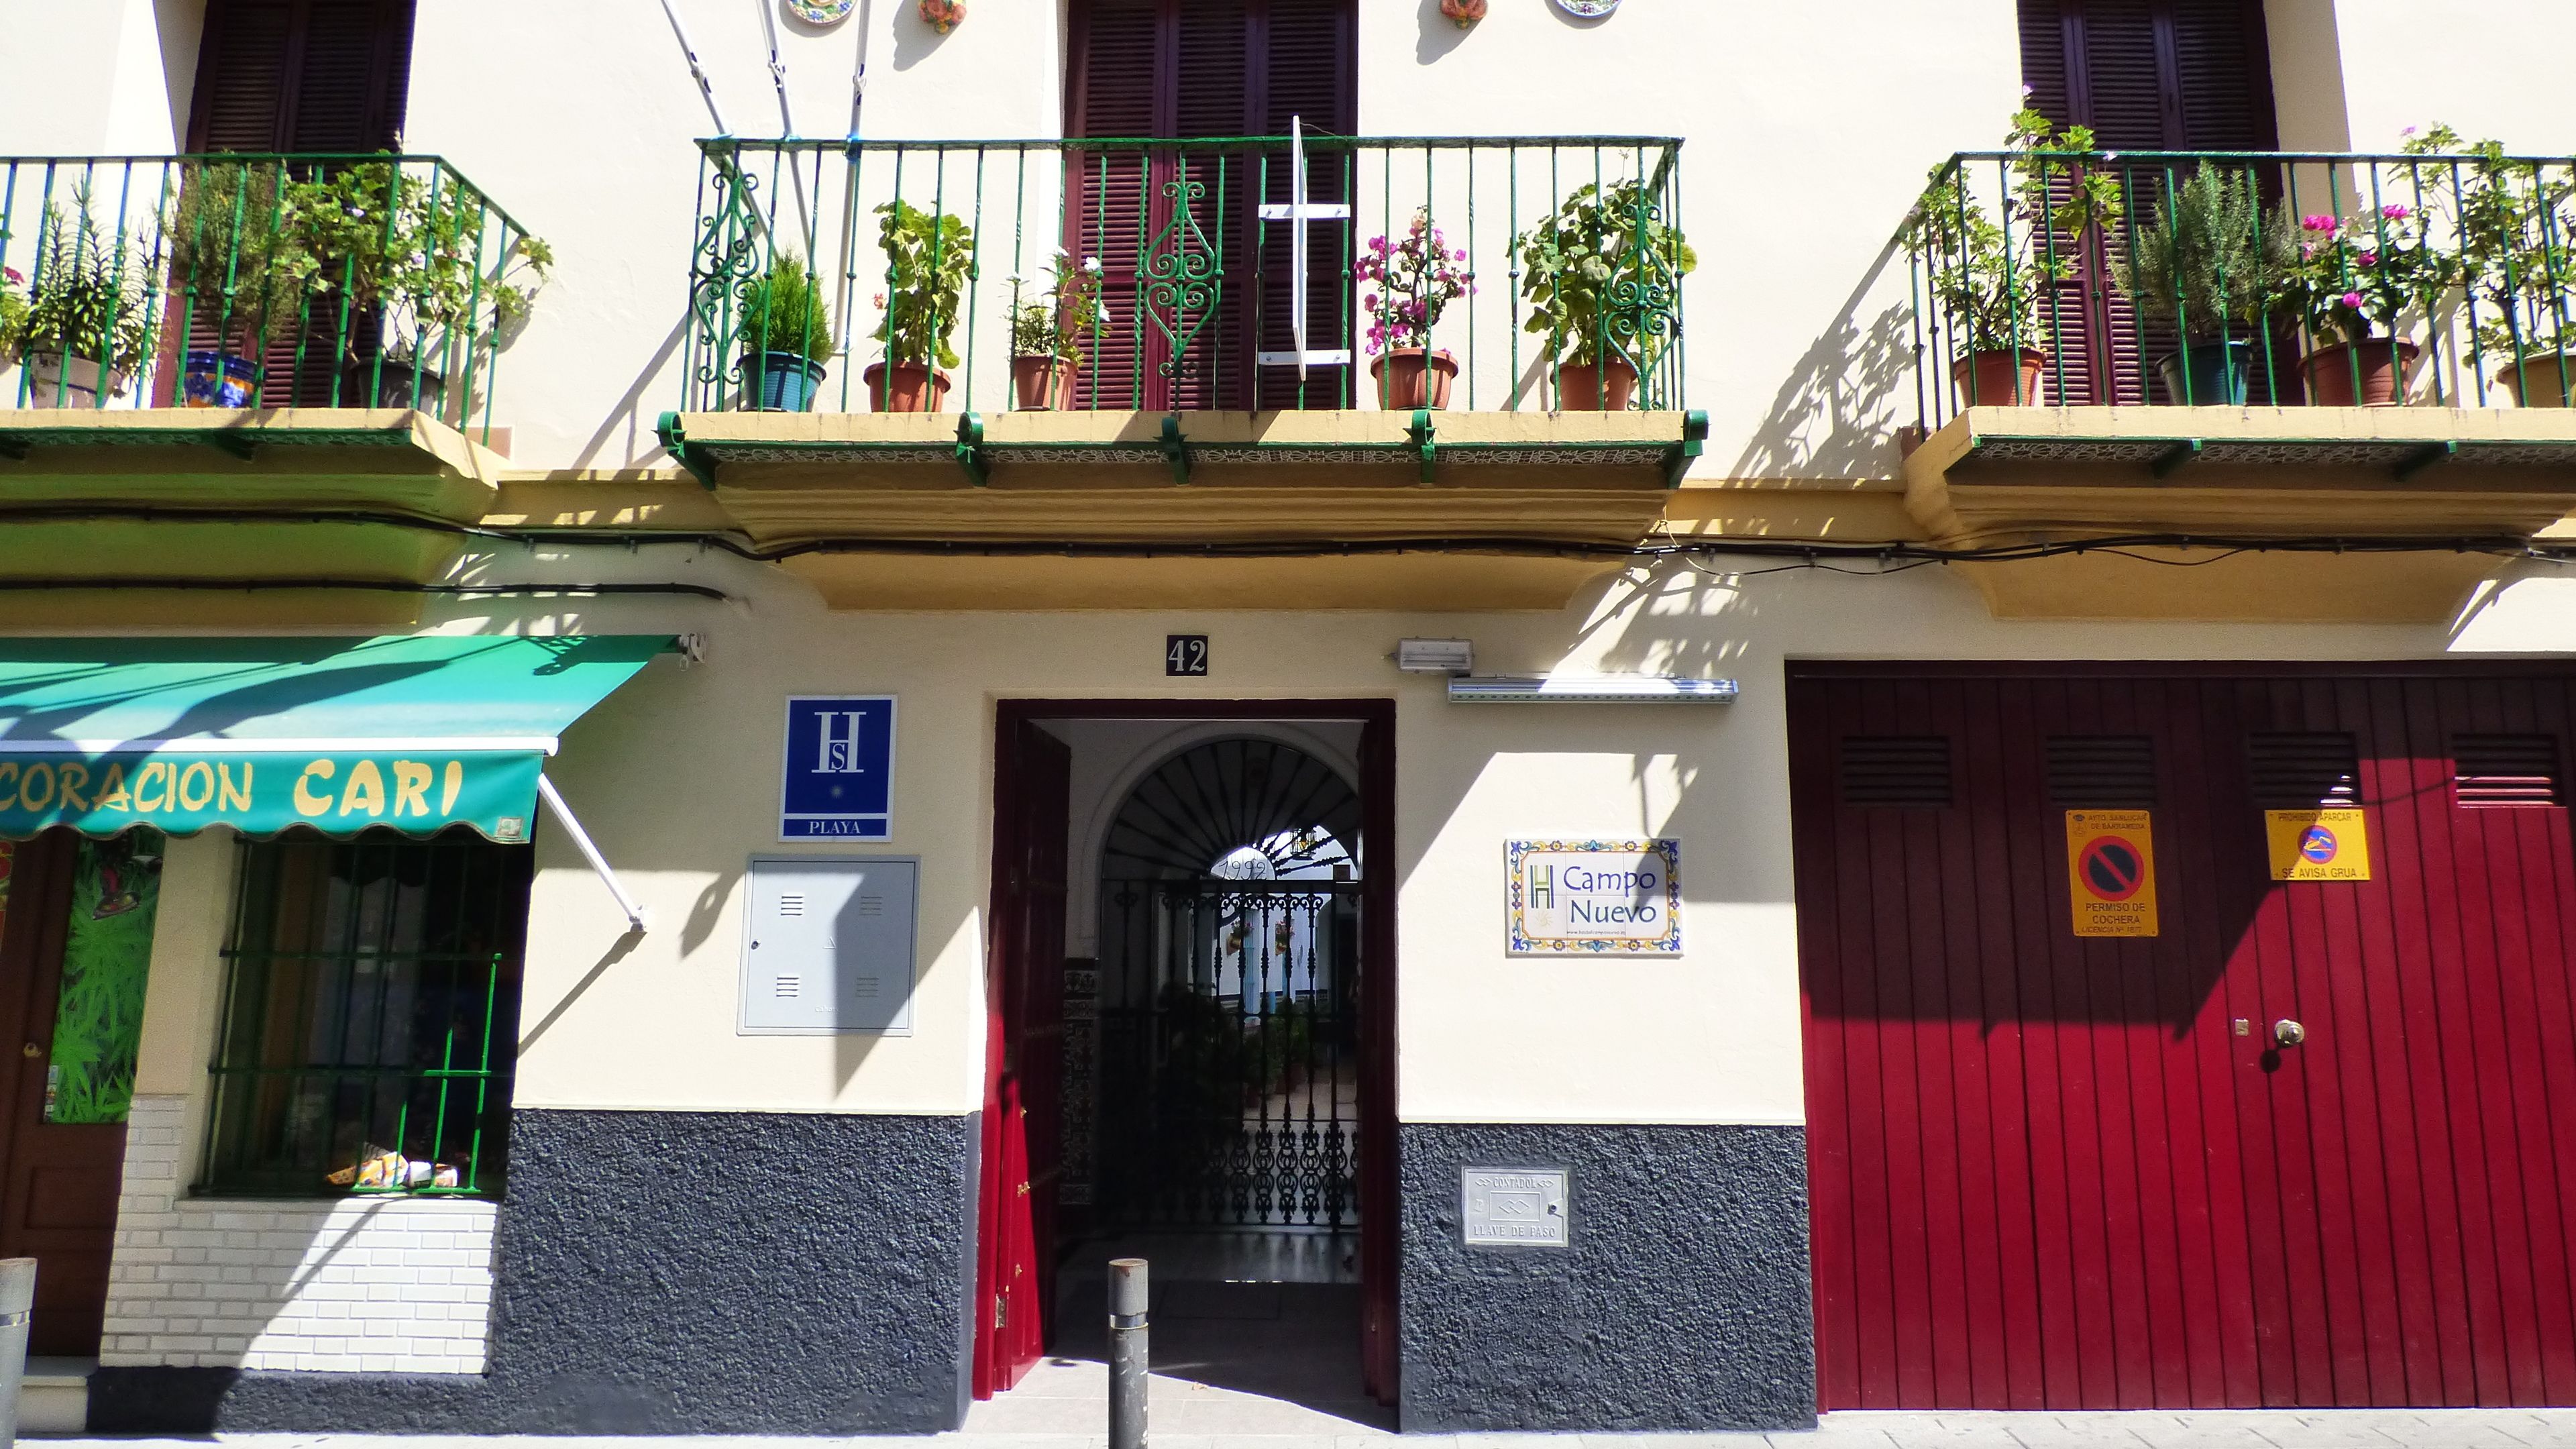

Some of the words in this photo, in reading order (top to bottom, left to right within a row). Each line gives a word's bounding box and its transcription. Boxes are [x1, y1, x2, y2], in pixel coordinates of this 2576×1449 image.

[1169, 640, 1205, 672] 42
[0, 761, 253, 812] CORACION
[294, 759, 463, 817] CARI
[2320, 812, 2352, 822] APARCAR
[808, 821, 861, 834] PLAYA
[1218, 860, 1267, 880] 1992
[2282, 868, 2294, 878] SE
[2299, 868, 2326, 878] AVISA
[2330, 868, 2357, 878] GRUA
[1564, 866, 1656, 897] Campo
[1570, 900, 1657, 923] Nuevo
[2086, 903, 2129, 912] PERMISO
[2133, 903, 2145, 912] DE
[2092, 915, 2140, 924] COCHERA
[1474, 1224, 1505, 1236] LLAVE
[1511, 1226, 1525, 1236] DE
[1530, 1226, 1556, 1238] PASO
